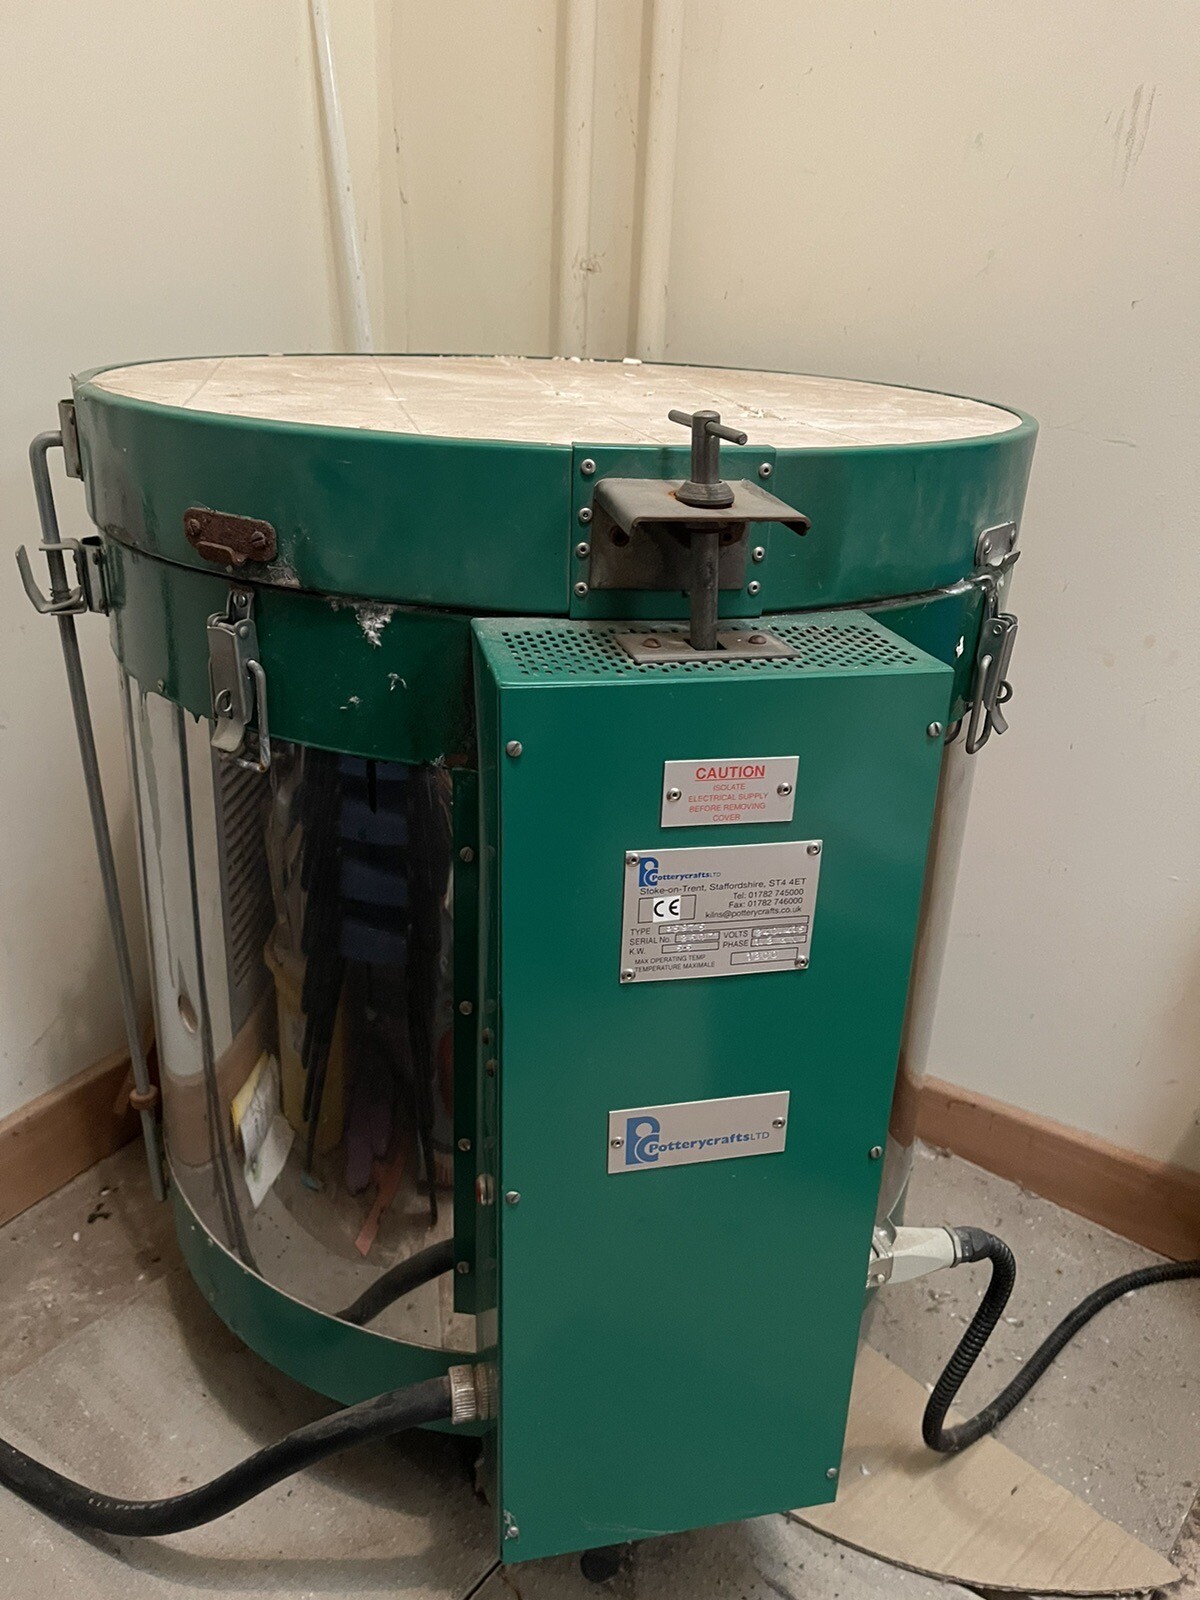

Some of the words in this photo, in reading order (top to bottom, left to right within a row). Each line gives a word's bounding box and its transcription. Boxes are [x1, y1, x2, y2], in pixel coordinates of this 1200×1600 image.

[695, 765, 766, 779] CAUTION
[713, 783, 746, 791] ISOLATE
[688, 794, 736, 803] ELECTRICAL
[738, 792, 769, 801] SUPPLY
[689, 805, 721, 813] BEFORE
[723, 802, 766, 811] REMOVING
[712, 814, 741, 822] COVER
[640, 886, 707, 896] Stoke-on-Trent,
[709, 881, 766, 891] Staffordshire,
[768, 879, 787, 888] ST4
[788, 878, 806, 886] 4ET
[733, 892, 747, 900] Tel:
[748, 890, 773, 899] 01782
[728, 901, 746, 909] Fax:
[747, 899, 772, 907] 01782
[705, 906, 802, 919] kilns@potterycrafts.co.uk
[630, 928, 651, 936] TYPE
[723, 930, 749, 938] VOLTS
[629, 938, 658, 946] SERIAL
[722, 940, 749, 948] PHASE
[650, 955, 687, 964] OPERATING
[635, 963, 681, 972] TEMPERATURE
[682, 960, 715, 968] MAXIMALE
